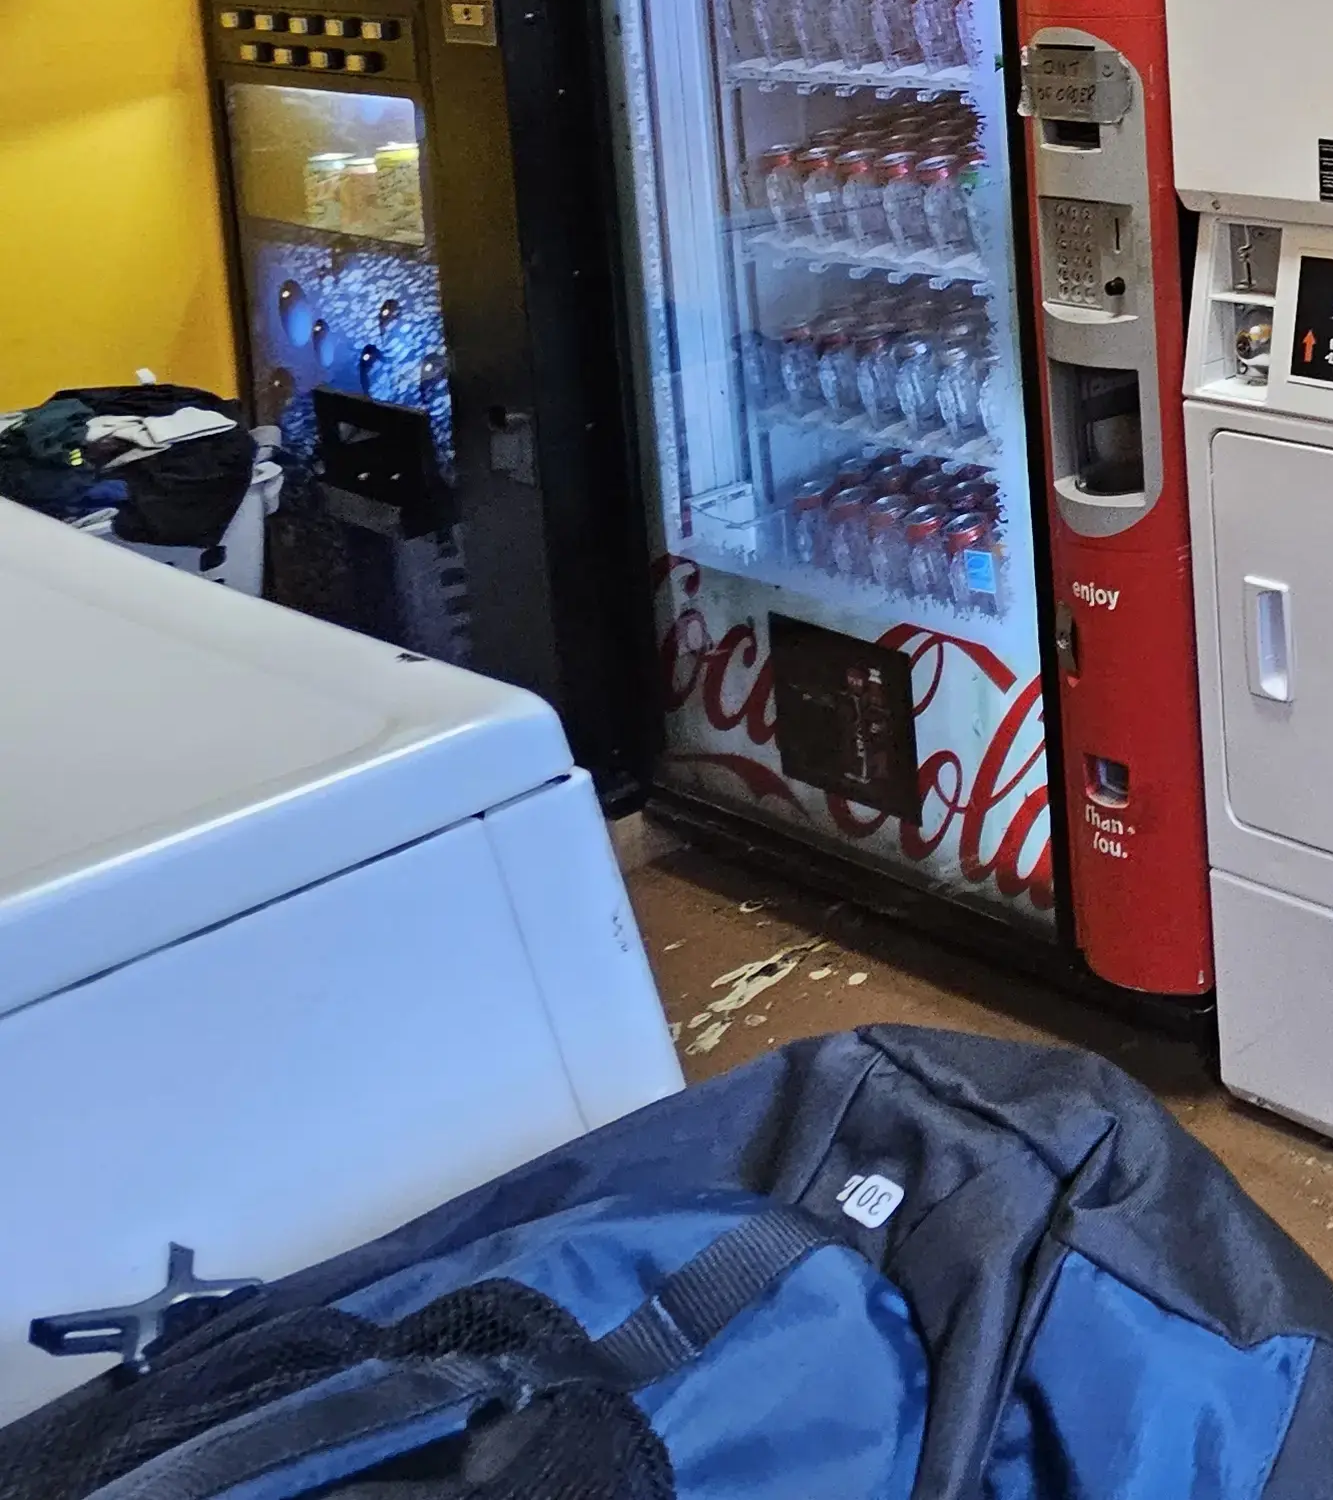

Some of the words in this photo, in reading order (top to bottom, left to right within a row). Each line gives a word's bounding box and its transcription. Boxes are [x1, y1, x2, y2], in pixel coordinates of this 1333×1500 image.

[1042, 59, 1080, 75] OUT
[1056, 84, 1097, 104] ORDER
[1072, 579, 1121, 611] enjoy
